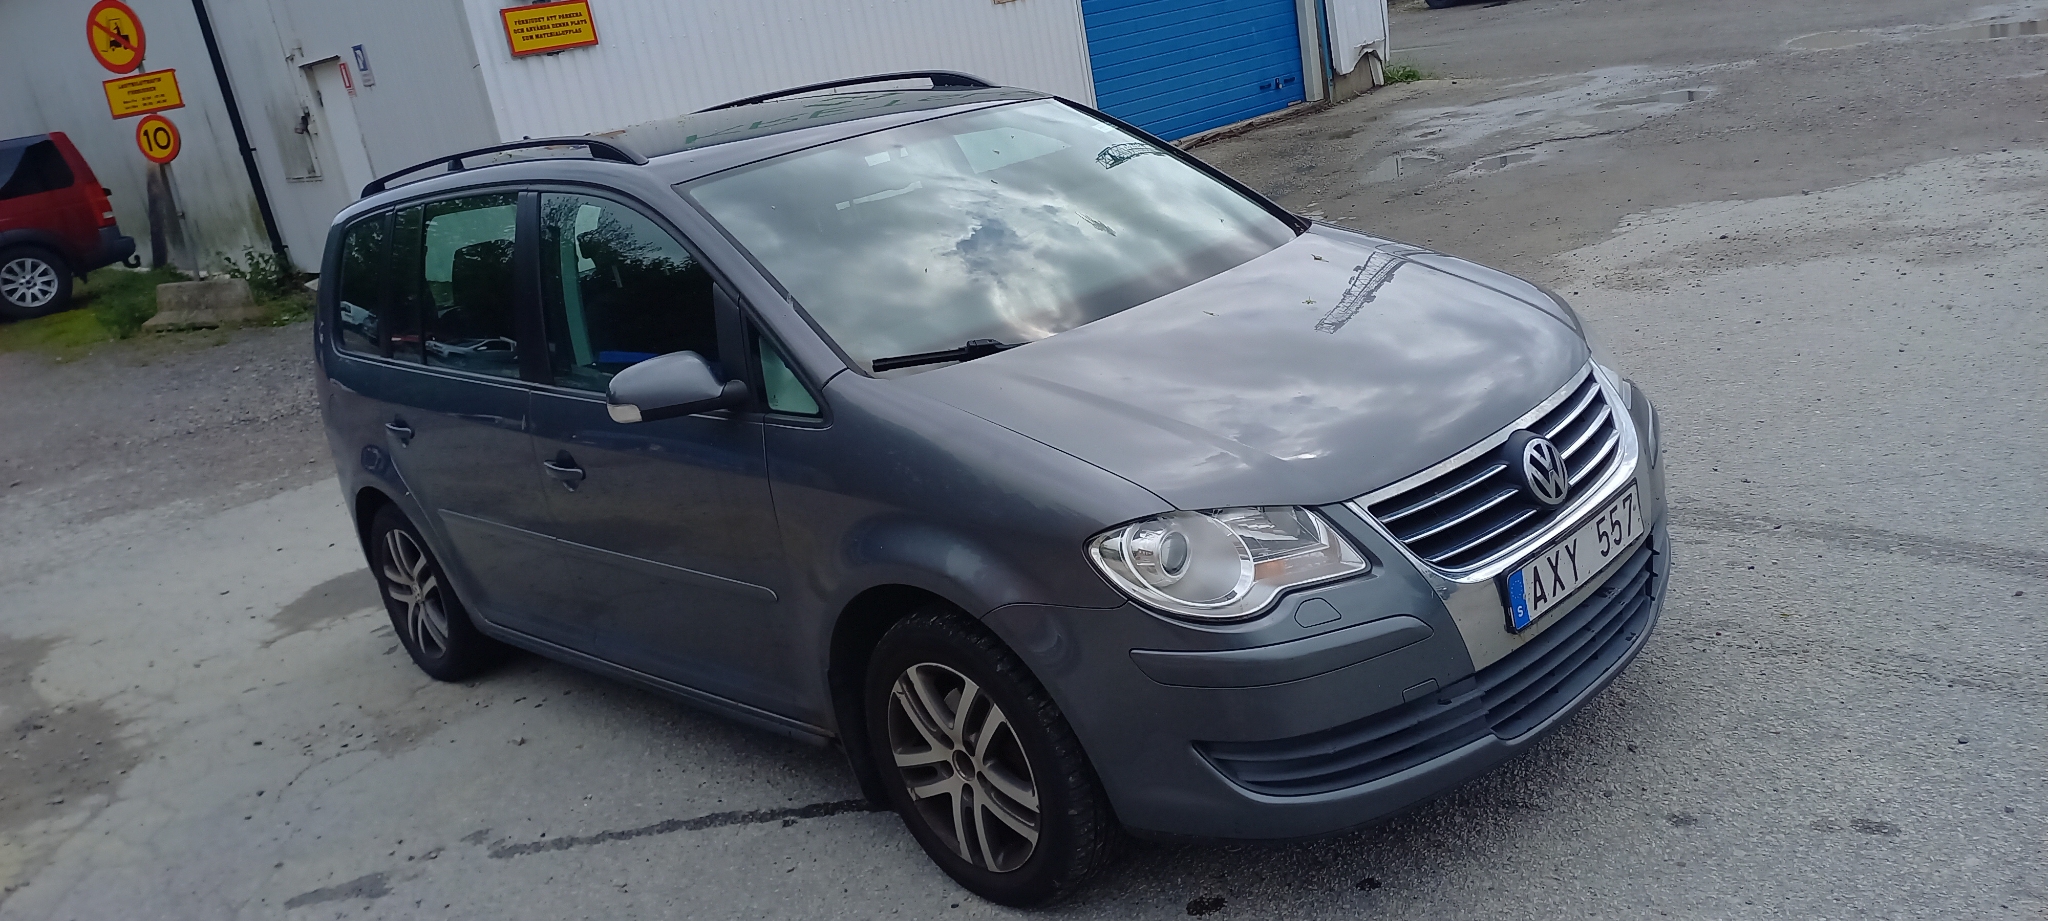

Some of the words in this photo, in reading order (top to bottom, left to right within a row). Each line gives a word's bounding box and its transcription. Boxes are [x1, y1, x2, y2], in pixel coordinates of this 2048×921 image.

[546, 14, 557, 22] ATT
[558, 11, 583, 19] PARKERA
[143, 127, 170, 151] 10
[1533, 538, 1579, 611] AXY
[1595, 492, 1633, 557] 557
[1517, 605, 1524, 617] S
